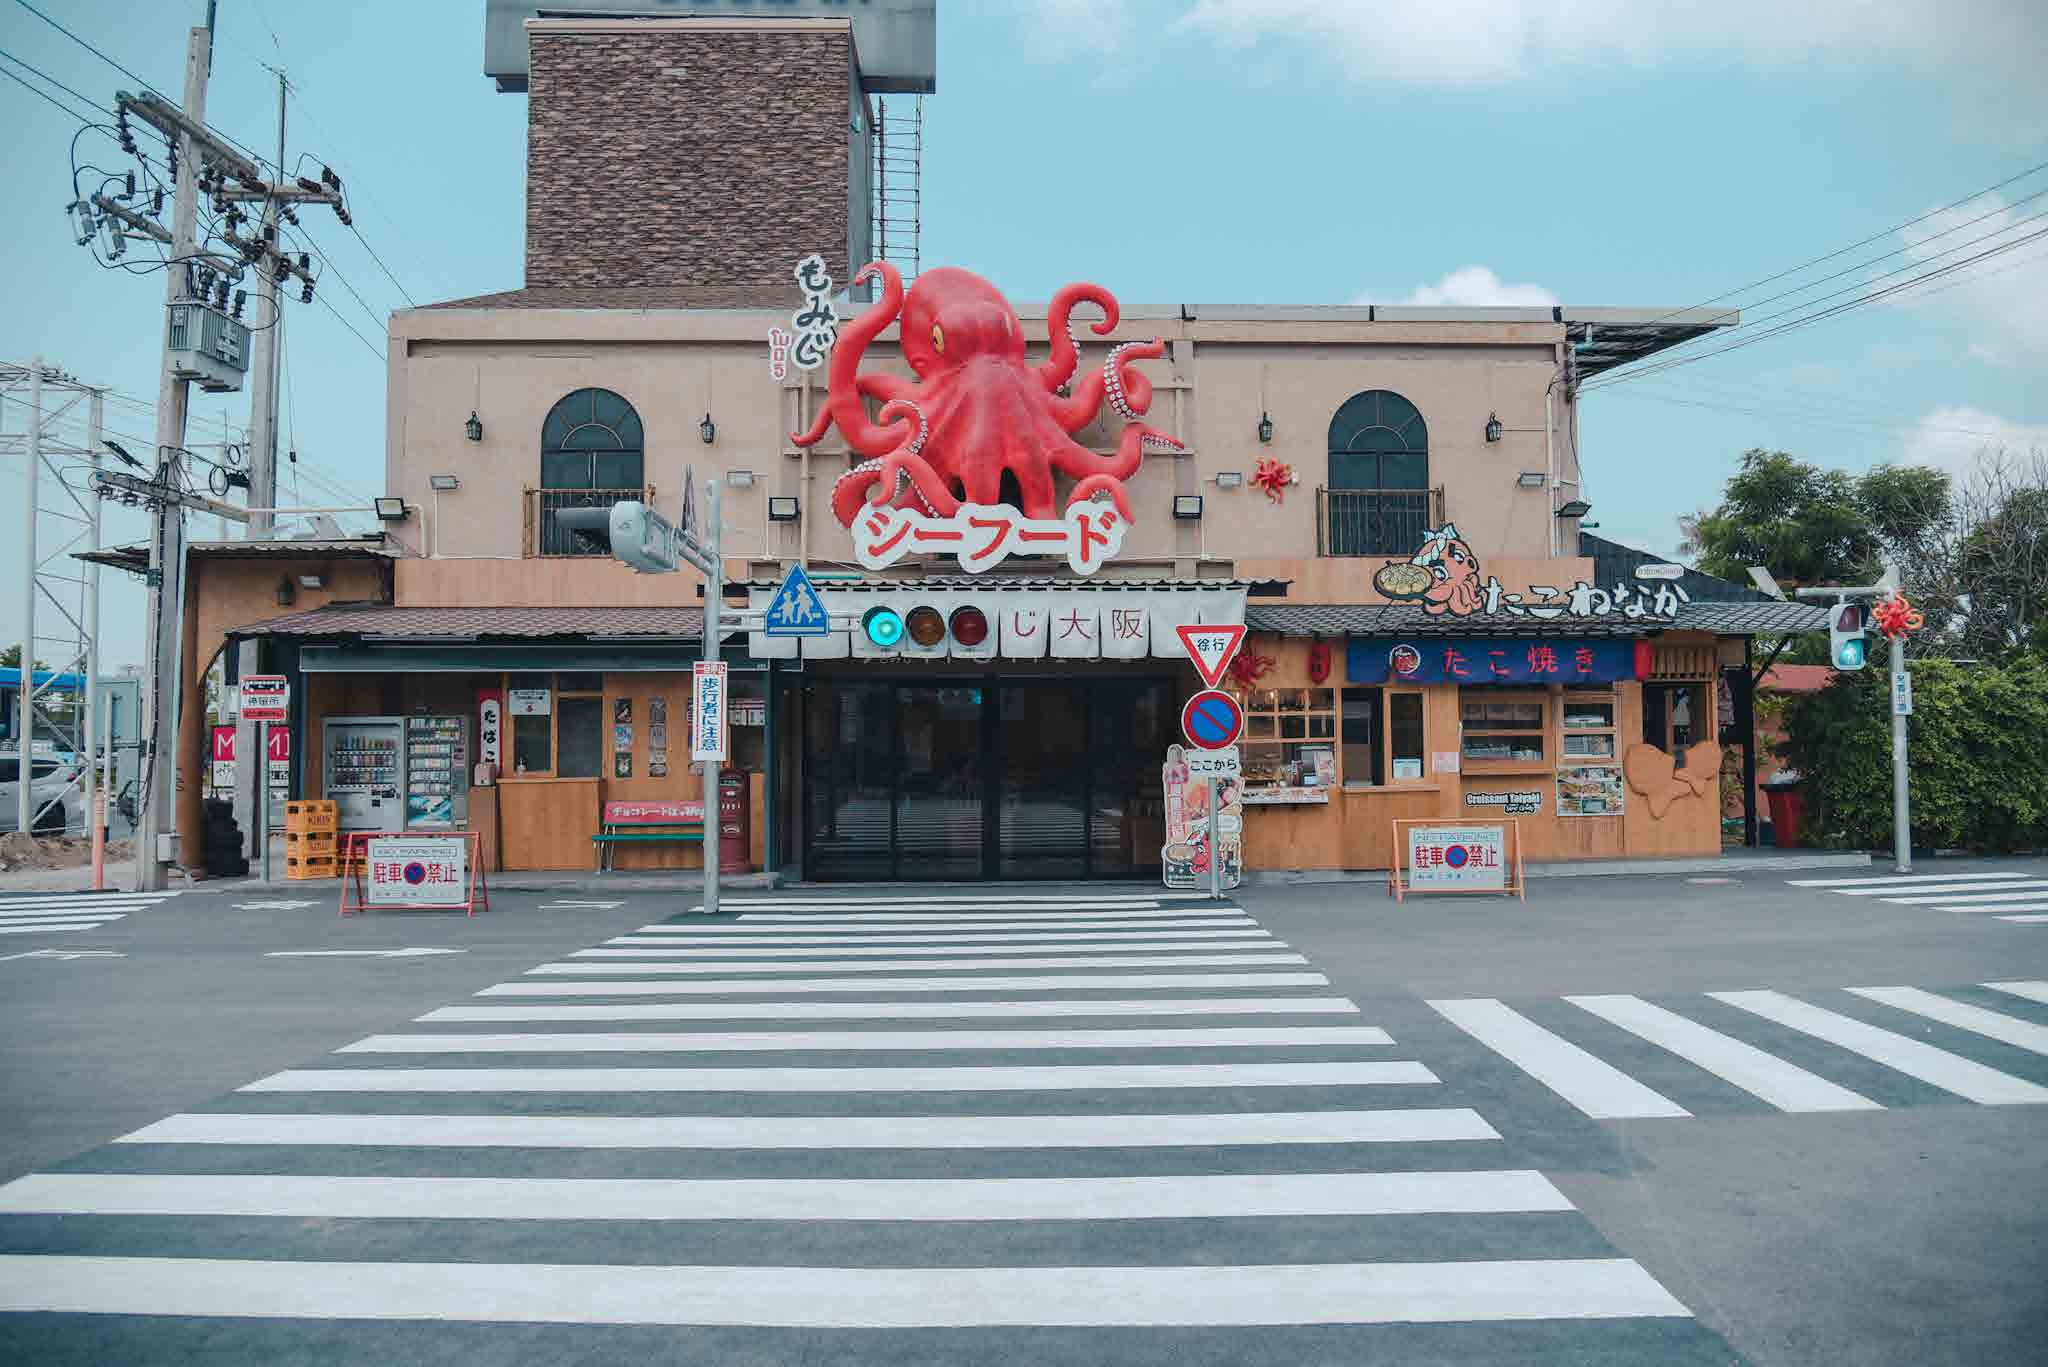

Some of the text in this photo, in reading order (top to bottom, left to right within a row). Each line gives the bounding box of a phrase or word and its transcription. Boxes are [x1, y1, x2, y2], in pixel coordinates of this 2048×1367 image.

[796, 260, 835, 366] もみじ
[865, 511, 1118, 563] シーフード
[1480, 576, 1691, 619] たこわなか
[1197, 638, 1225, 652] 徐行
[1443, 644, 1595, 677] たこ焼き
[701, 677, 719, 752] 歩行者に注意
[483, 710, 497, 764] たばこ
[1191, 760, 1237, 772] ここから
[1466, 793, 1508, 805] Croissant
[373, 862, 458, 884] 駐車 禁止
[1415, 844, 1498, 869] 駐車 禁止
